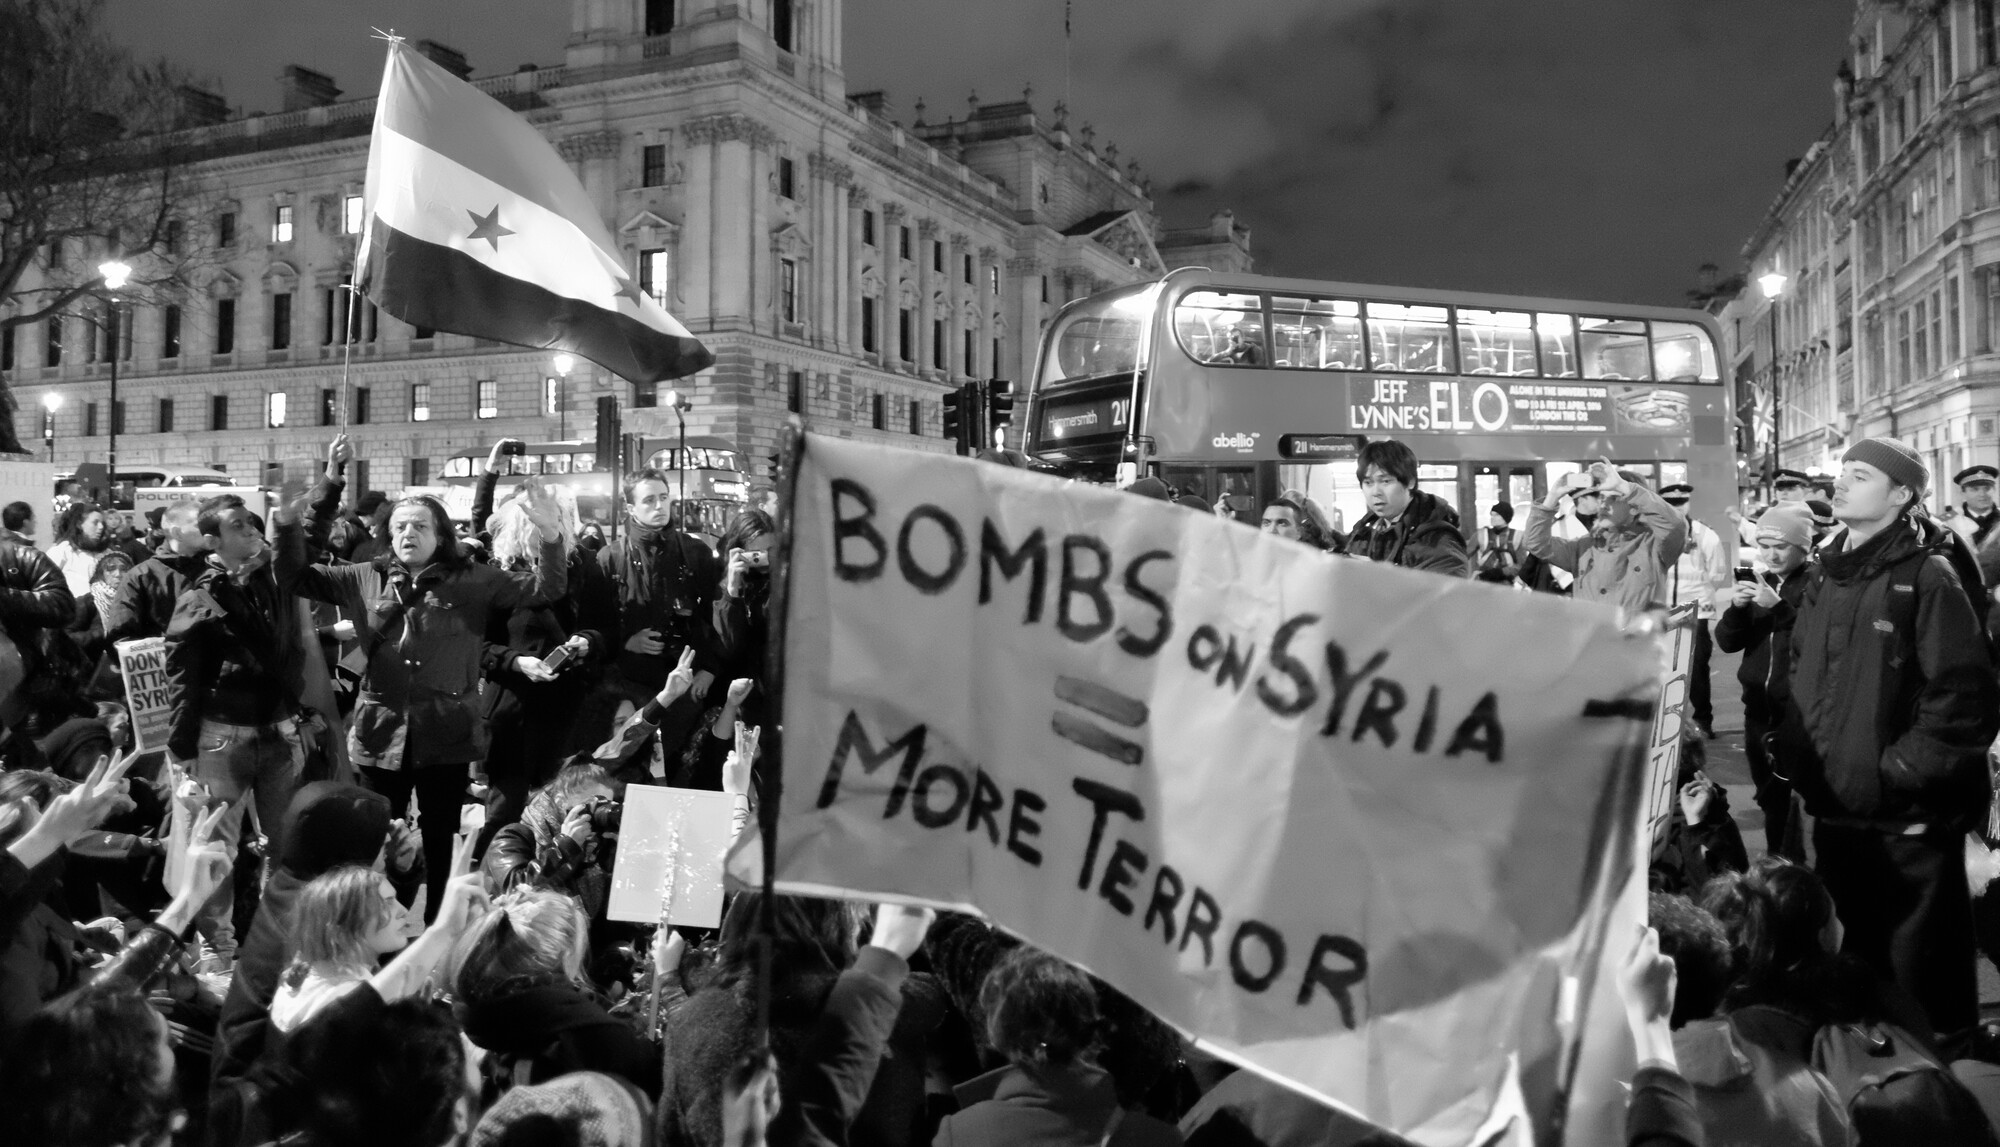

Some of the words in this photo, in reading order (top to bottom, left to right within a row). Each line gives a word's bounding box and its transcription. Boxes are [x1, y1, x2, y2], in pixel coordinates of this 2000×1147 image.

[1371, 380, 1408, 403] JEFF
[1509, 385, 1534, 396] ALONE
[1543, 386, 1557, 397] THE
[1588, 387, 1607, 398] TOUR
[1351, 405, 1429, 430] LYNNE'S
[1430, 382, 1509, 431] ELO
[1529, 410, 1562, 421] LONDON
[1562, 411, 1577, 421] THE
[1048, 409, 1098, 431] Hammersmith
[1212, 432, 1255, 448] abellio
[1294, 440, 1308, 454] 211
[1309, 443, 1356, 452] Hammersmith
[136, 493, 189, 501] POLICE
[830, 477, 1175, 659] BOMBS
[1255, 612, 1506, 764] SYRIA
[816, 708, 1047, 868] MORE
[1072, 776, 1369, 1030] TERROR
